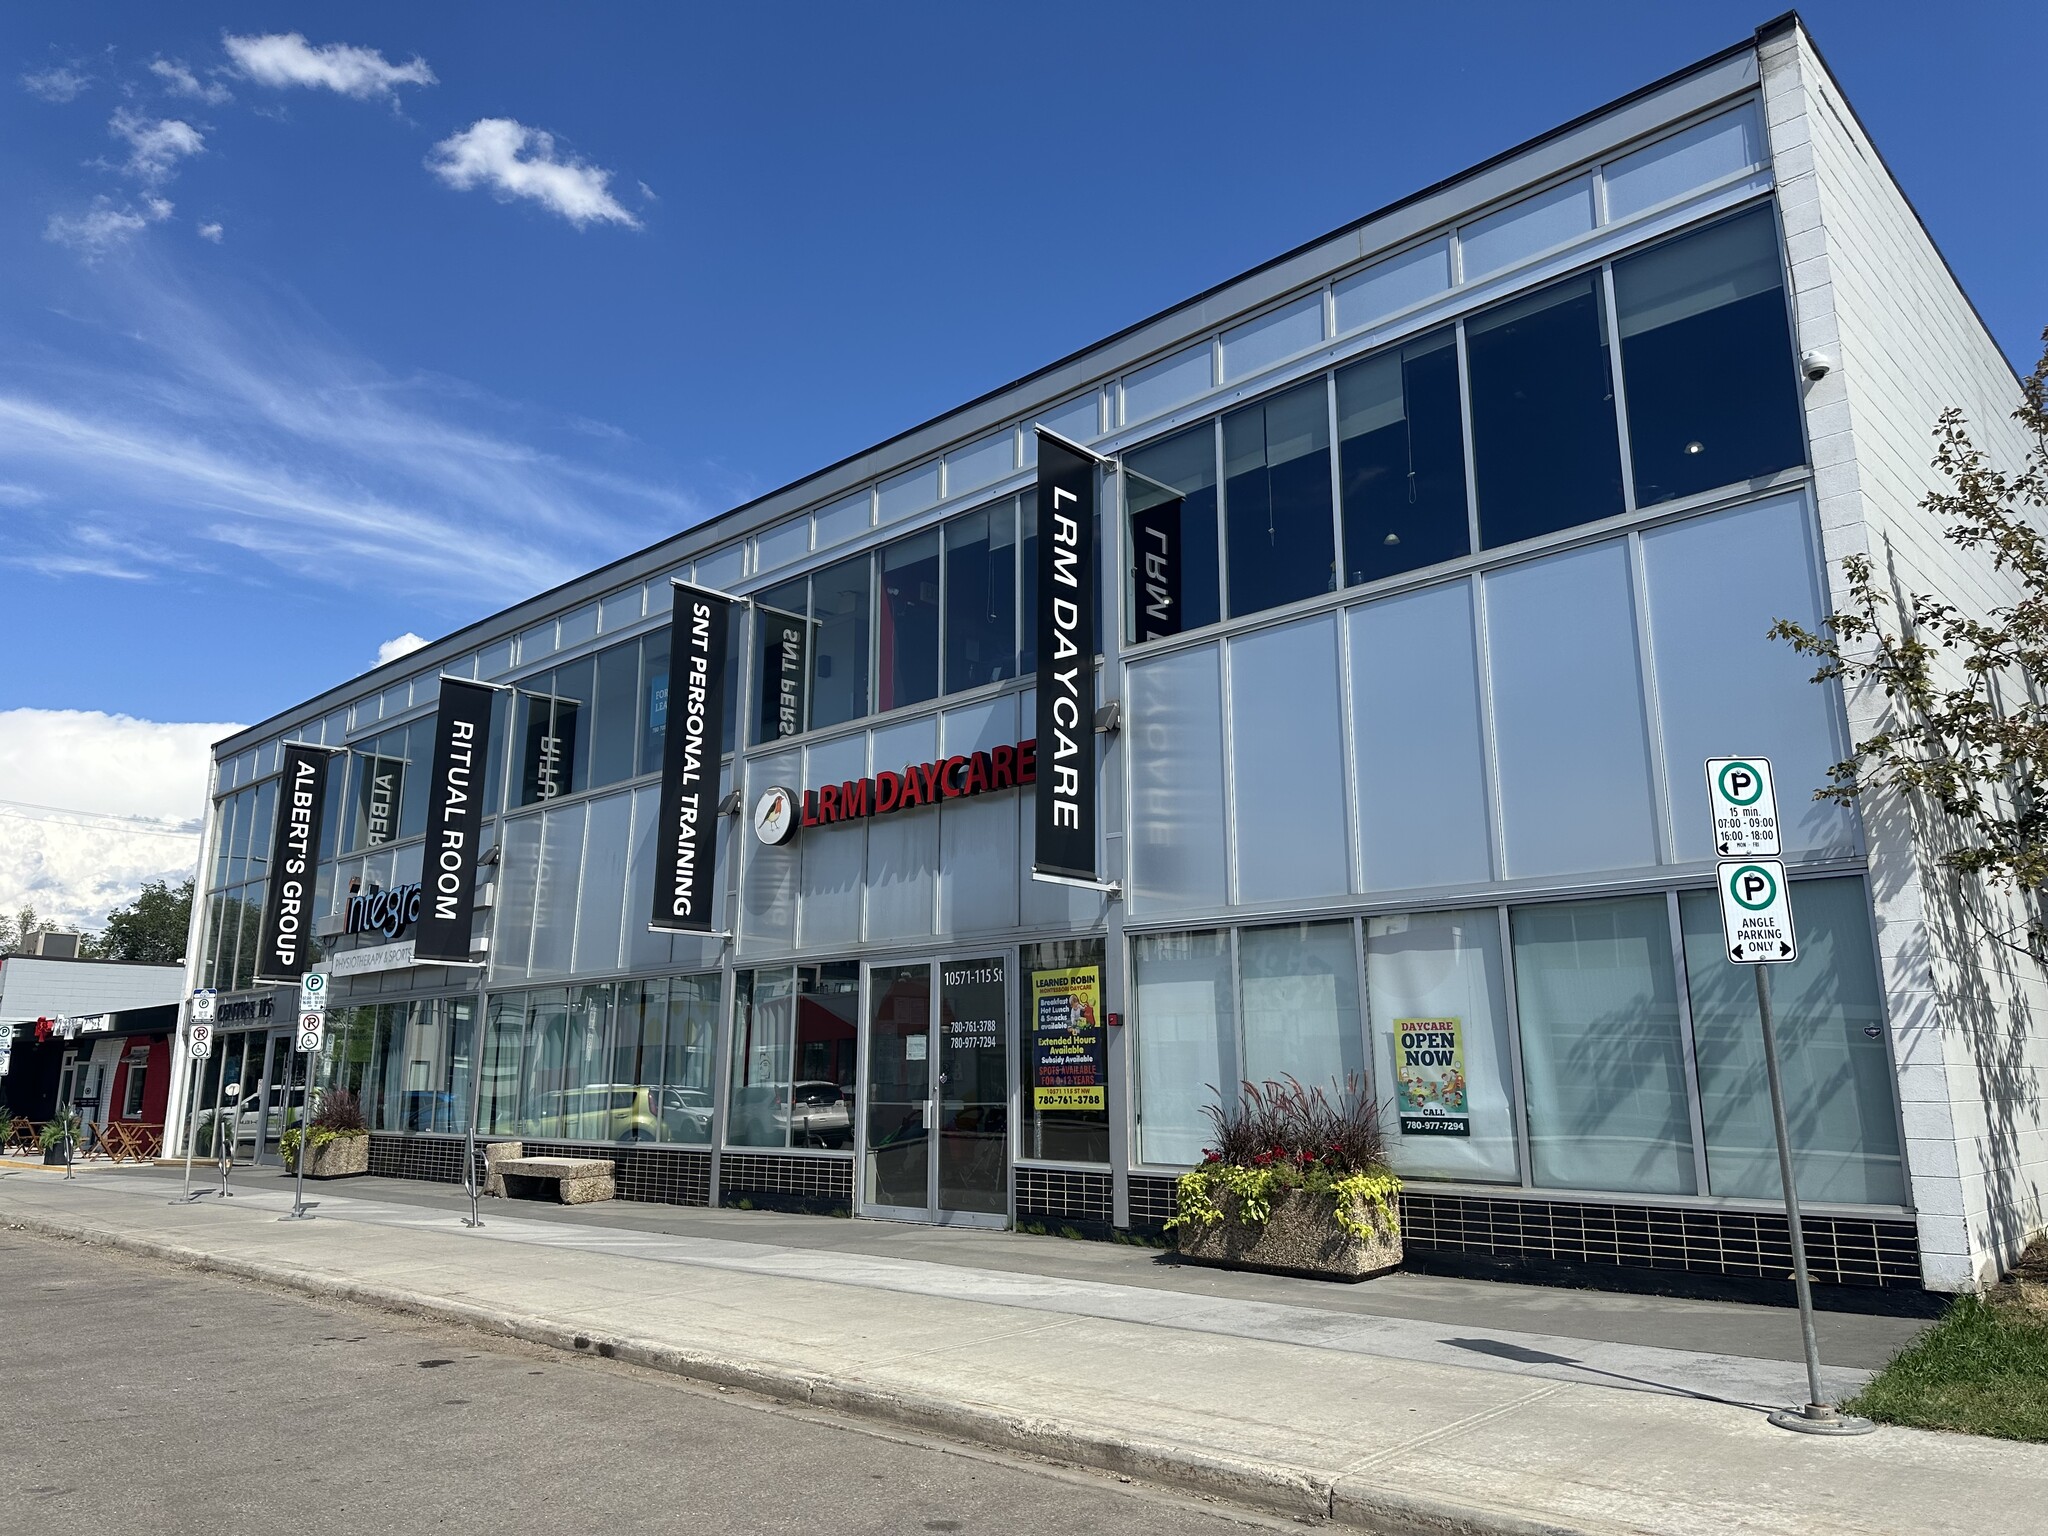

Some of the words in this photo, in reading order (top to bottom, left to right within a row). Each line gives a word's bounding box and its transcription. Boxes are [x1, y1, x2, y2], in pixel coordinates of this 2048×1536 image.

[1053, 486, 1078, 588] LRM
[692, 603, 711, 652] SNT
[1052, 598, 1079, 830] DAYCARE
[682, 656, 707, 785] PERSONAL
[444, 720, 474, 822] RITUAL
[802, 778, 869, 827] LRM
[875, 739, 1036, 814] DAYCARE
[286, 760, 316, 874] ALBERT'S
[1730, 807, 1738, 817] 15
[1743, 806, 1761, 817] min.
[1718, 818, 1741, 828] 07:00
[1749, 818, 1773, 827] 09:00
[1721, 831, 1743, 841] 16:00
[1751, 830, 1773, 840] 18:00
[673, 793, 699, 917] TRAINING
[435, 831, 464, 920] ROOM
[275, 881, 303, 966] GROUP
[1742, 917, 1775, 928] ANGLE
[1737, 929, 1782, 940] PARKING
[1748, 942, 1774, 952] ONLY
[335, 951, 383, 970] PHYSIOTHERAPY
[389, 947, 412, 962] SPORTS
[944, 969, 991, 986] 10571-115
[993, 968, 1003, 982] St
[1036, 978, 1068, 988] LEARNED
[1070, 975, 1095, 985] ROBIN
[1040, 998, 1068, 1006] Breakfast
[950, 1020, 996, 1033] 780-761-3788
[1040, 1022, 1067, 1030] available
[1401, 1022, 1453, 1031] DAYCARE
[950, 1036, 996, 1048] 780-977-7294
[1038, 1036, 1072, 1046] Extended
[1074, 1036, 1096, 1044] Hours
[1401, 1033, 1455, 1048] OPEN
[1050, 1045, 1084, 1054] Available
[1041, 1056, 1064, 1065] Subsidy
[1065, 1055, 1093, 1063] Available
[1405, 1050, 1454, 1066] NOW
[1039, 1066, 1060, 1075] SPOTS
[1062, 1065, 1096, 1074] AVAILABLE
[1041, 1076, 1054, 1085] FOR
[1073, 1076, 1095, 1084] YEARS
[1038, 1095, 1100, 1104] 780-761-3788
[1406, 1121, 1464, 1130] 780-977-7294
